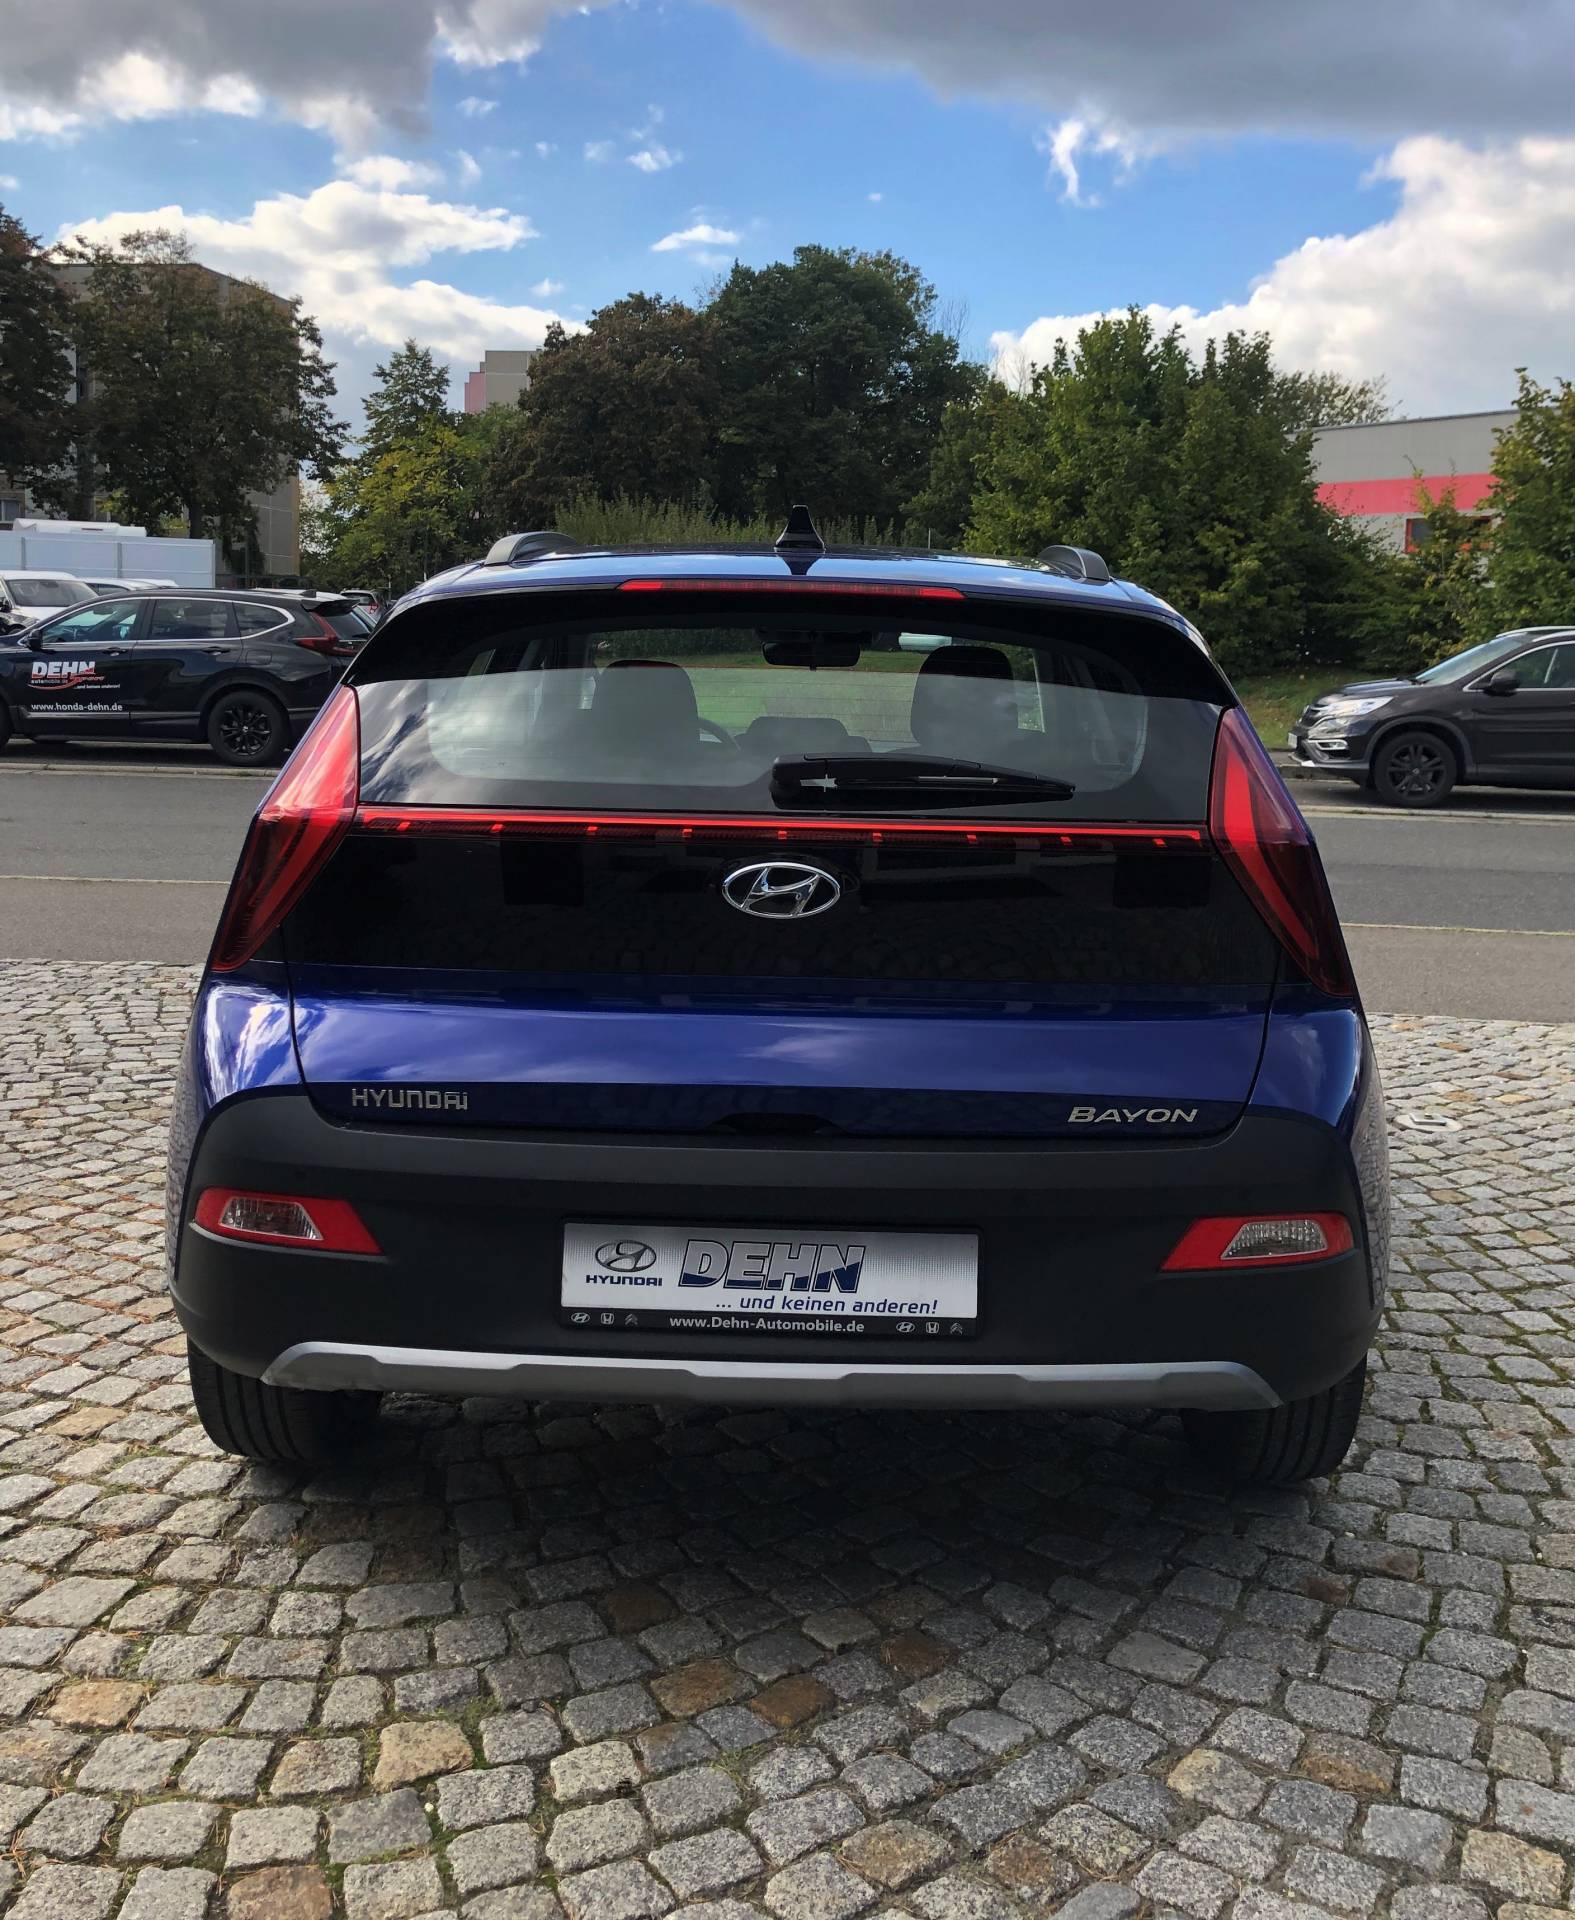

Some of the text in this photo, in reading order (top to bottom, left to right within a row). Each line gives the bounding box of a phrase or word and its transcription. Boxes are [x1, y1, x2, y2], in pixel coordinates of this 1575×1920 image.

[31, 661, 96, 679] DEHN
[31, 702, 123, 711] www.honda-dehn.de
[351, 1088, 468, 1110] HYUNDAI
[1067, 1106, 1198, 1122] BAYON
[678, 1239, 866, 1293] DEHN
[585, 1274, 663, 1287] HYUNDAI
[740, 1296, 775, 1309] und
[781, 1296, 845, 1312] keinen
[852, 1299, 938, 1314] anderen!
[669, 1315, 865, 1332] www.Dehn-Automobile.de
